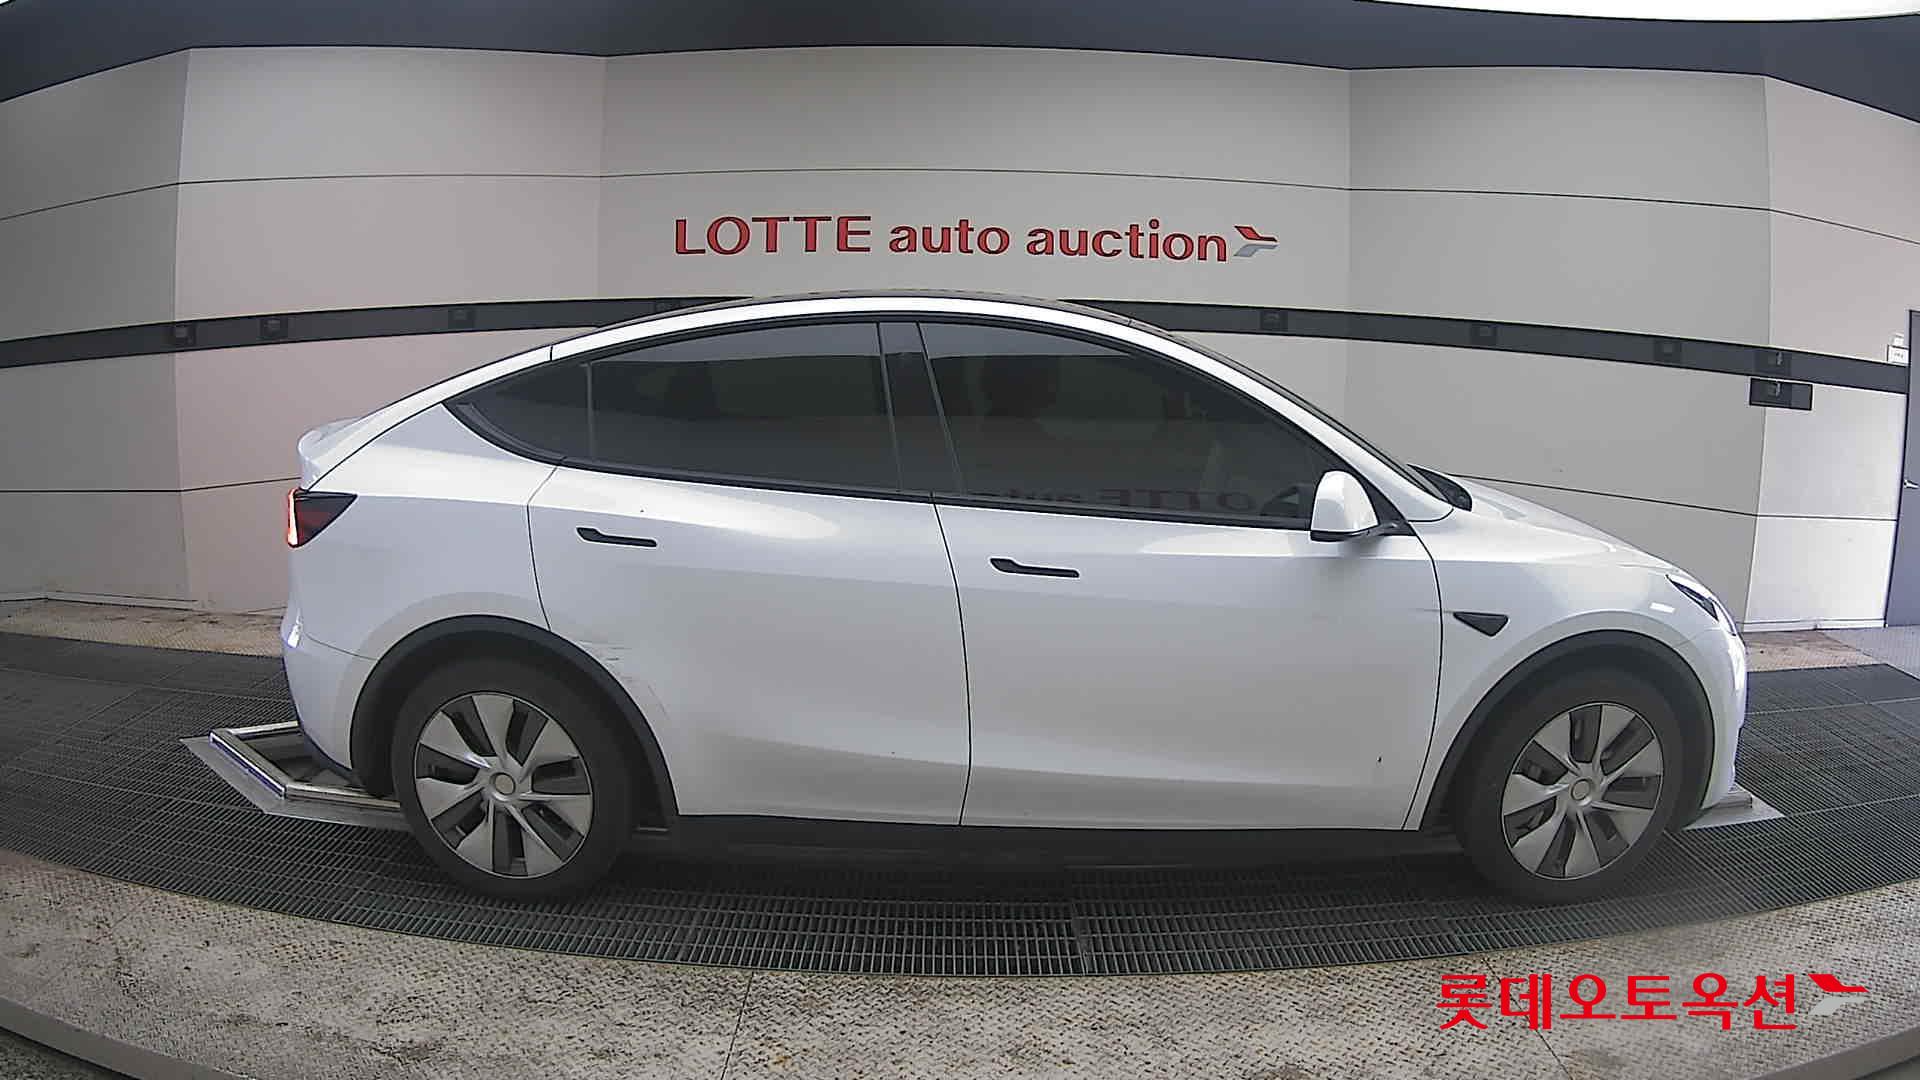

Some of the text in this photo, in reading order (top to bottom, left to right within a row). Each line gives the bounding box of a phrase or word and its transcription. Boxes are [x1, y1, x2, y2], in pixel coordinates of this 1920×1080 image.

[675, 215, 1228, 262] LOTTE auto auction
